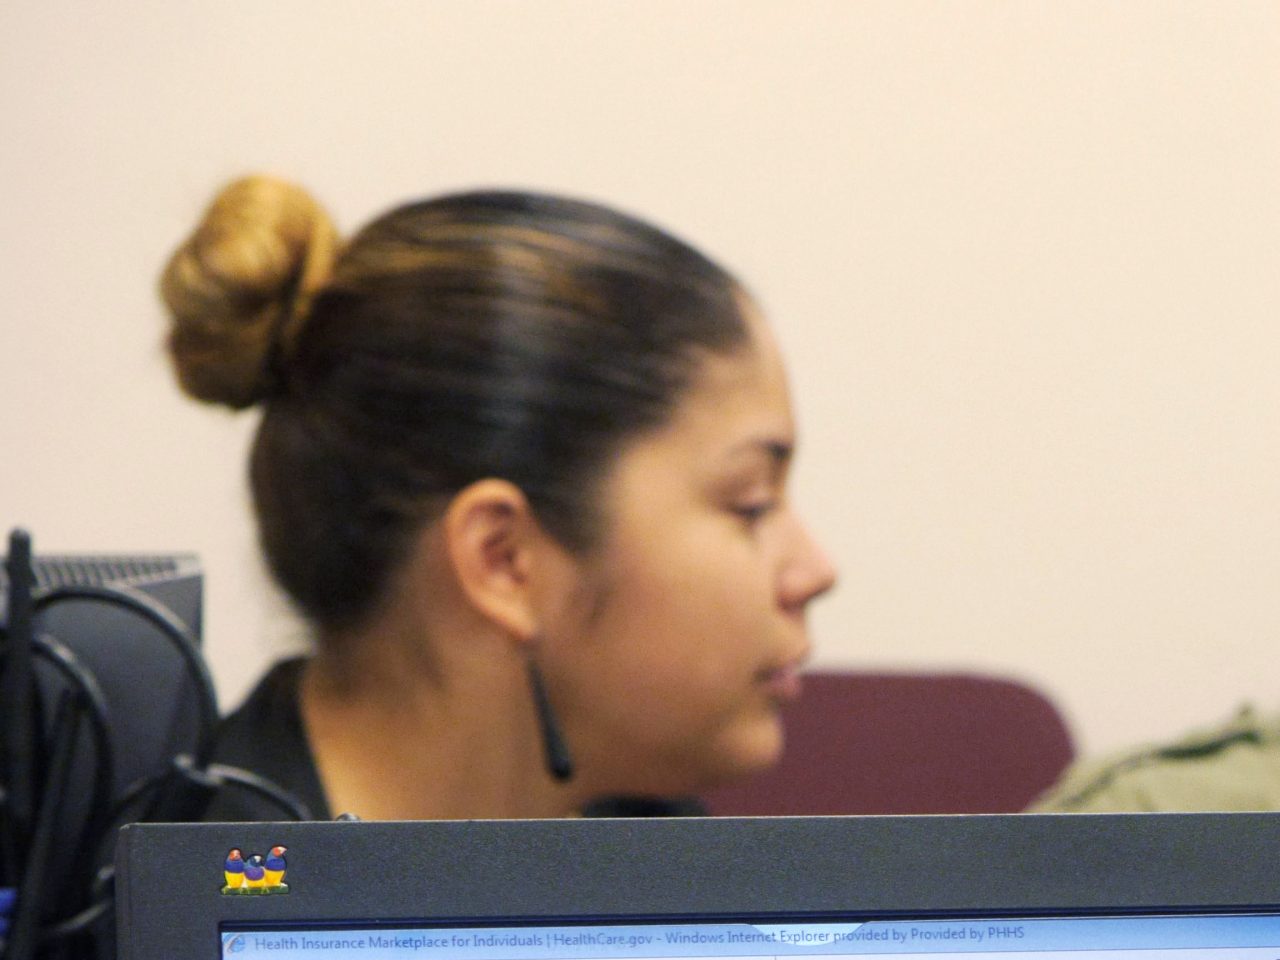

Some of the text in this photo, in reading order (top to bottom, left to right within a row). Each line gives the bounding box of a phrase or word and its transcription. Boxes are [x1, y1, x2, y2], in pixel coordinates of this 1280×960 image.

[255, 936, 297, 951] Health
[301, 934, 365, 950] Insurance
[368, 933, 447, 952] Marketplace
[451, 933, 469, 948] for
[473, 932, 543, 949] Individuals
[554, 932, 652, 949] HealthCare.gov
[665, 930, 724, 944] Windows
[728, 929, 776, 943] Internet
[780, 928, 830, 945] Explorer
[833, 927, 889, 945] provided
[893, 926, 907, 943] by
[911, 926, 966, 941] Provided
[970, 925, 984, 942] by
[988, 926, 1025, 939] PHHS
